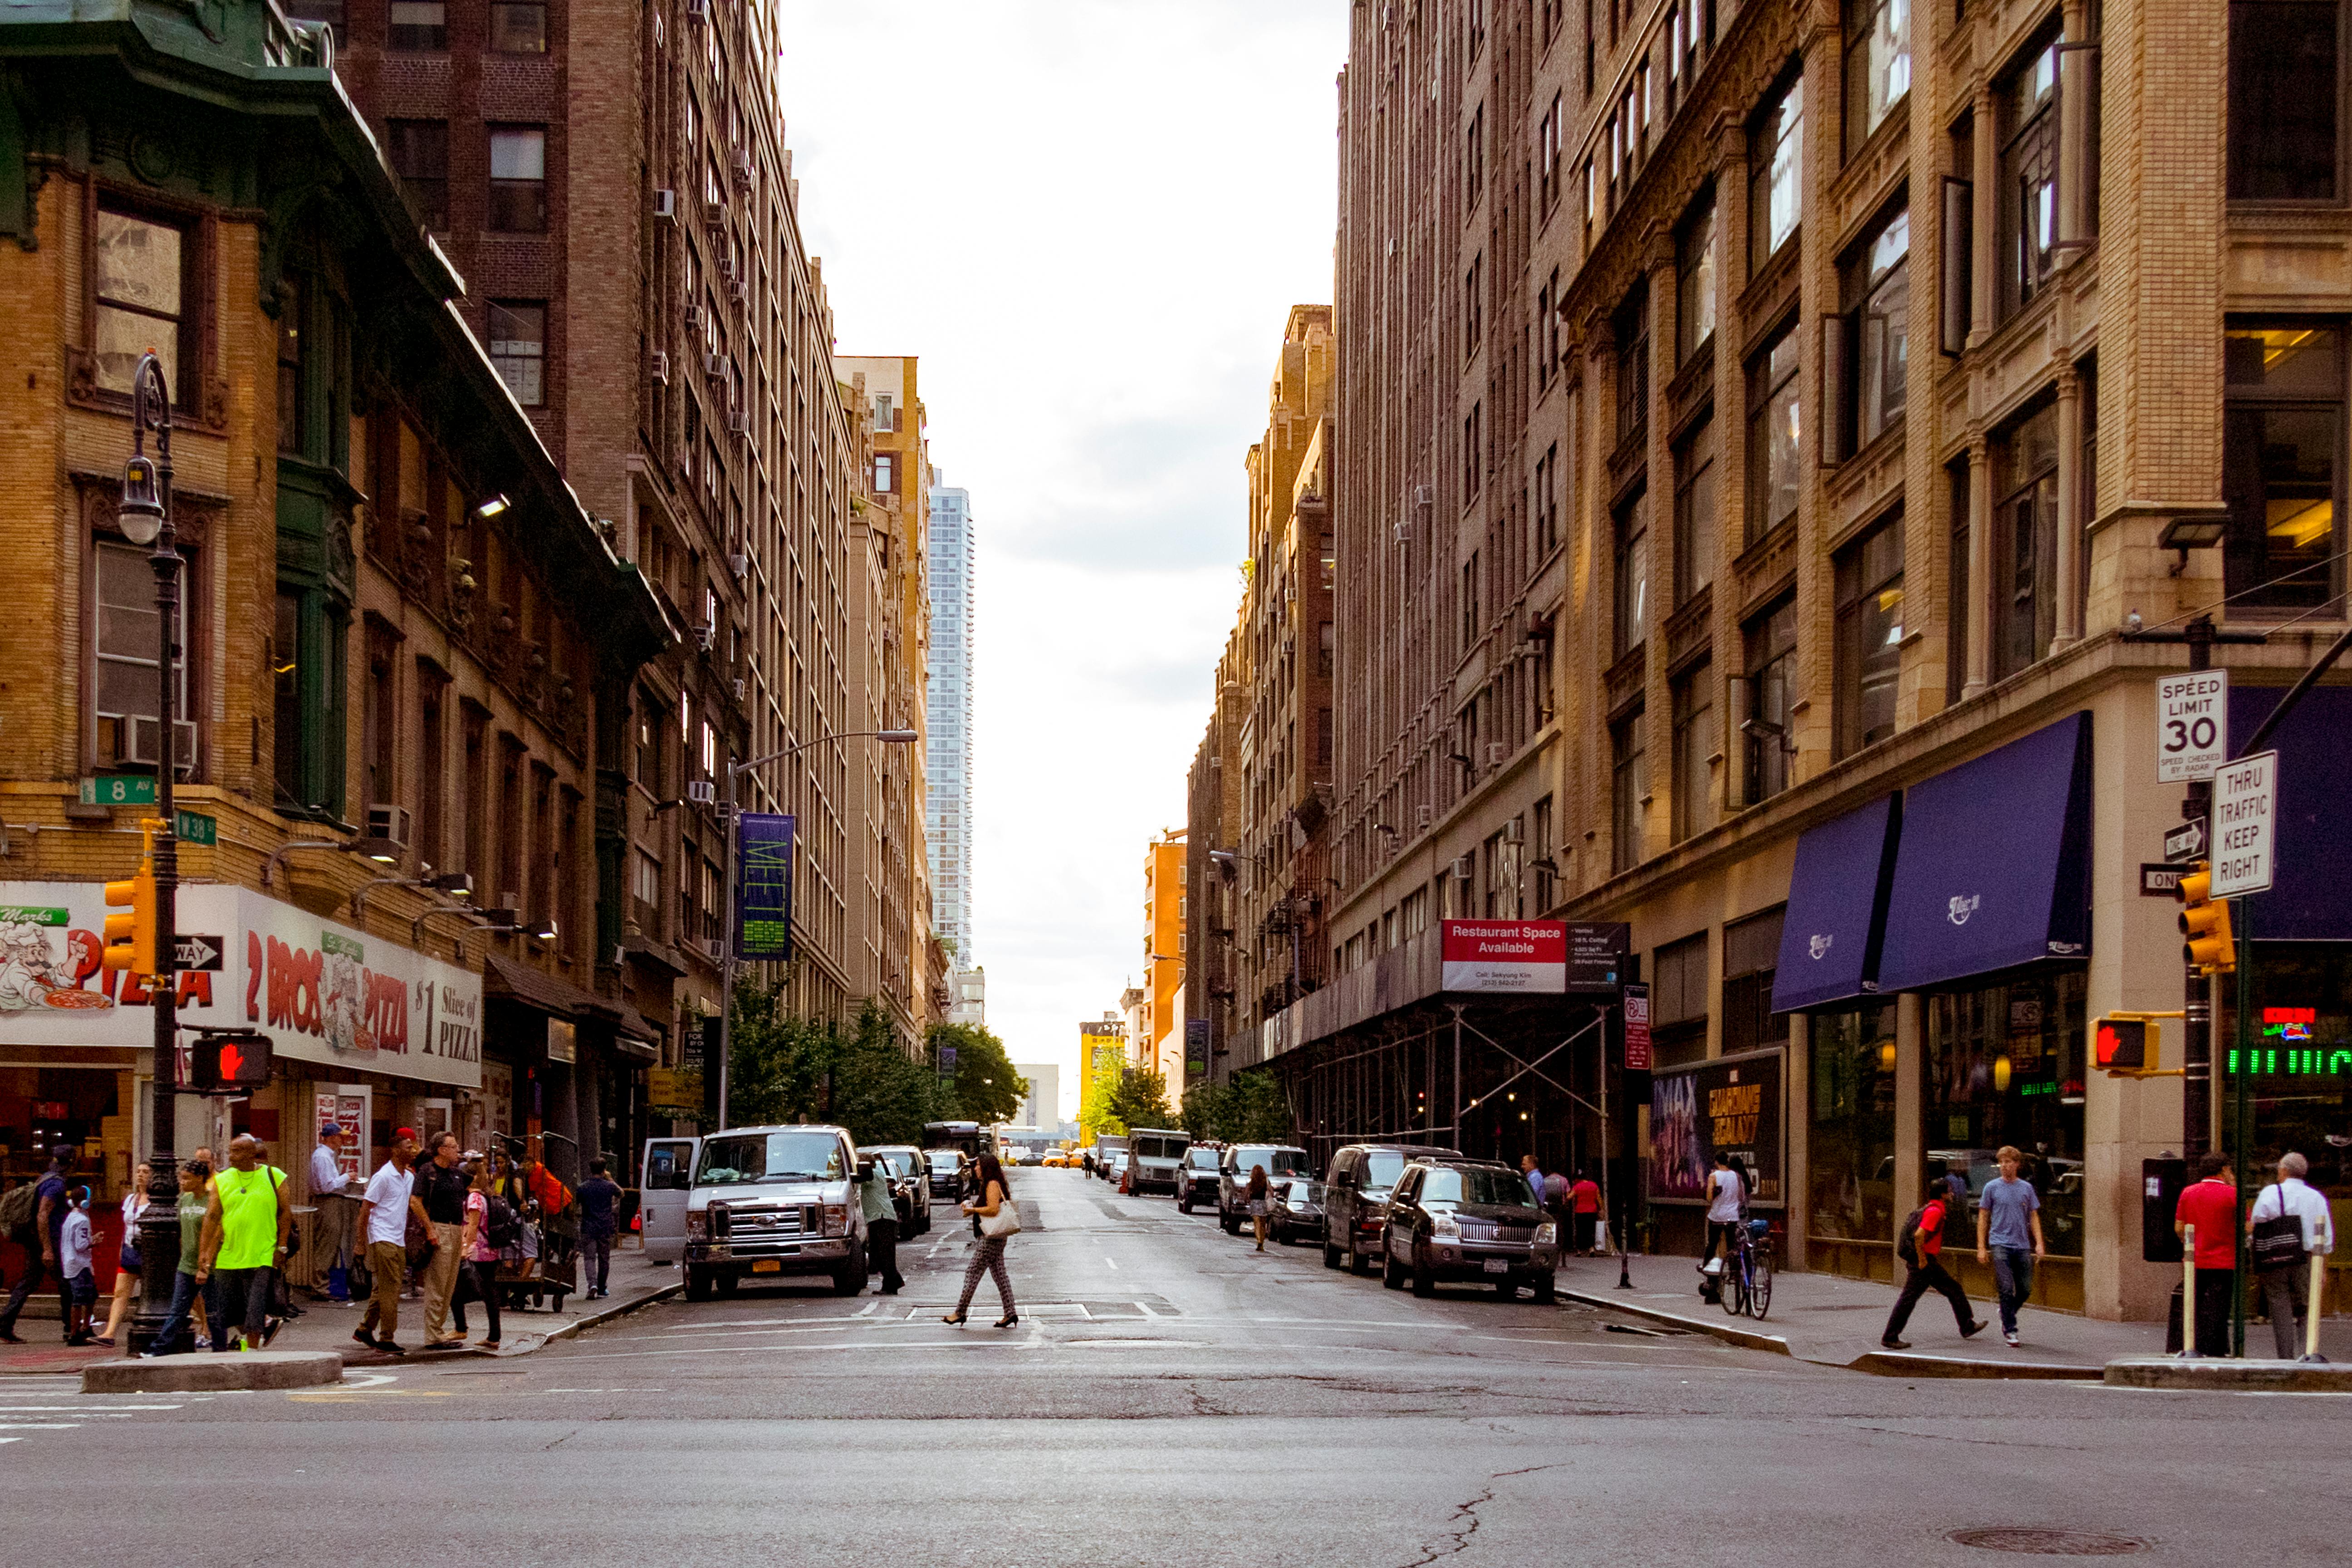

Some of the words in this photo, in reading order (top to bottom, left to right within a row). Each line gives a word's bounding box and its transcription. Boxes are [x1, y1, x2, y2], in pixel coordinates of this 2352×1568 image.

[2163, 680, 2220, 699] SPEED
[2169, 699, 2213, 716] LIMIT
[2164, 717, 2216, 752] 30
[2161, 757, 2184, 766] SPEED
[2188, 753, 2220, 763] CHECKED
[2185, 763, 2210, 772] RADAR
[112, 781, 126, 801] 8
[137, 781, 151, 791] AV
[2227, 767, 2262, 794] THRU
[2220, 795, 2267, 824] TRAFFIC
[191, 818, 204, 840] 38
[2224, 825, 2259, 851] KEEP
[745, 840, 788, 918] MEET
[2220, 854, 2260, 882] RIGHT
[0, 907, 52, 921] Marks
[1453, 926, 1519, 938] Restaurant
[1523, 927, 1561, 941] Space
[175, 946, 206, 960] WAY
[1478, 942, 1535, 954] Available
[246, 929, 263, 1023] 2
[266, 935, 325, 1038] BROS
[415, 976, 434, 1054] $1
[441, 985, 465, 1018] Slice
[467, 993, 477, 1025] of
[438, 1020, 479, 1063] PIZZA
[81, 1227, 88, 1239] 3
